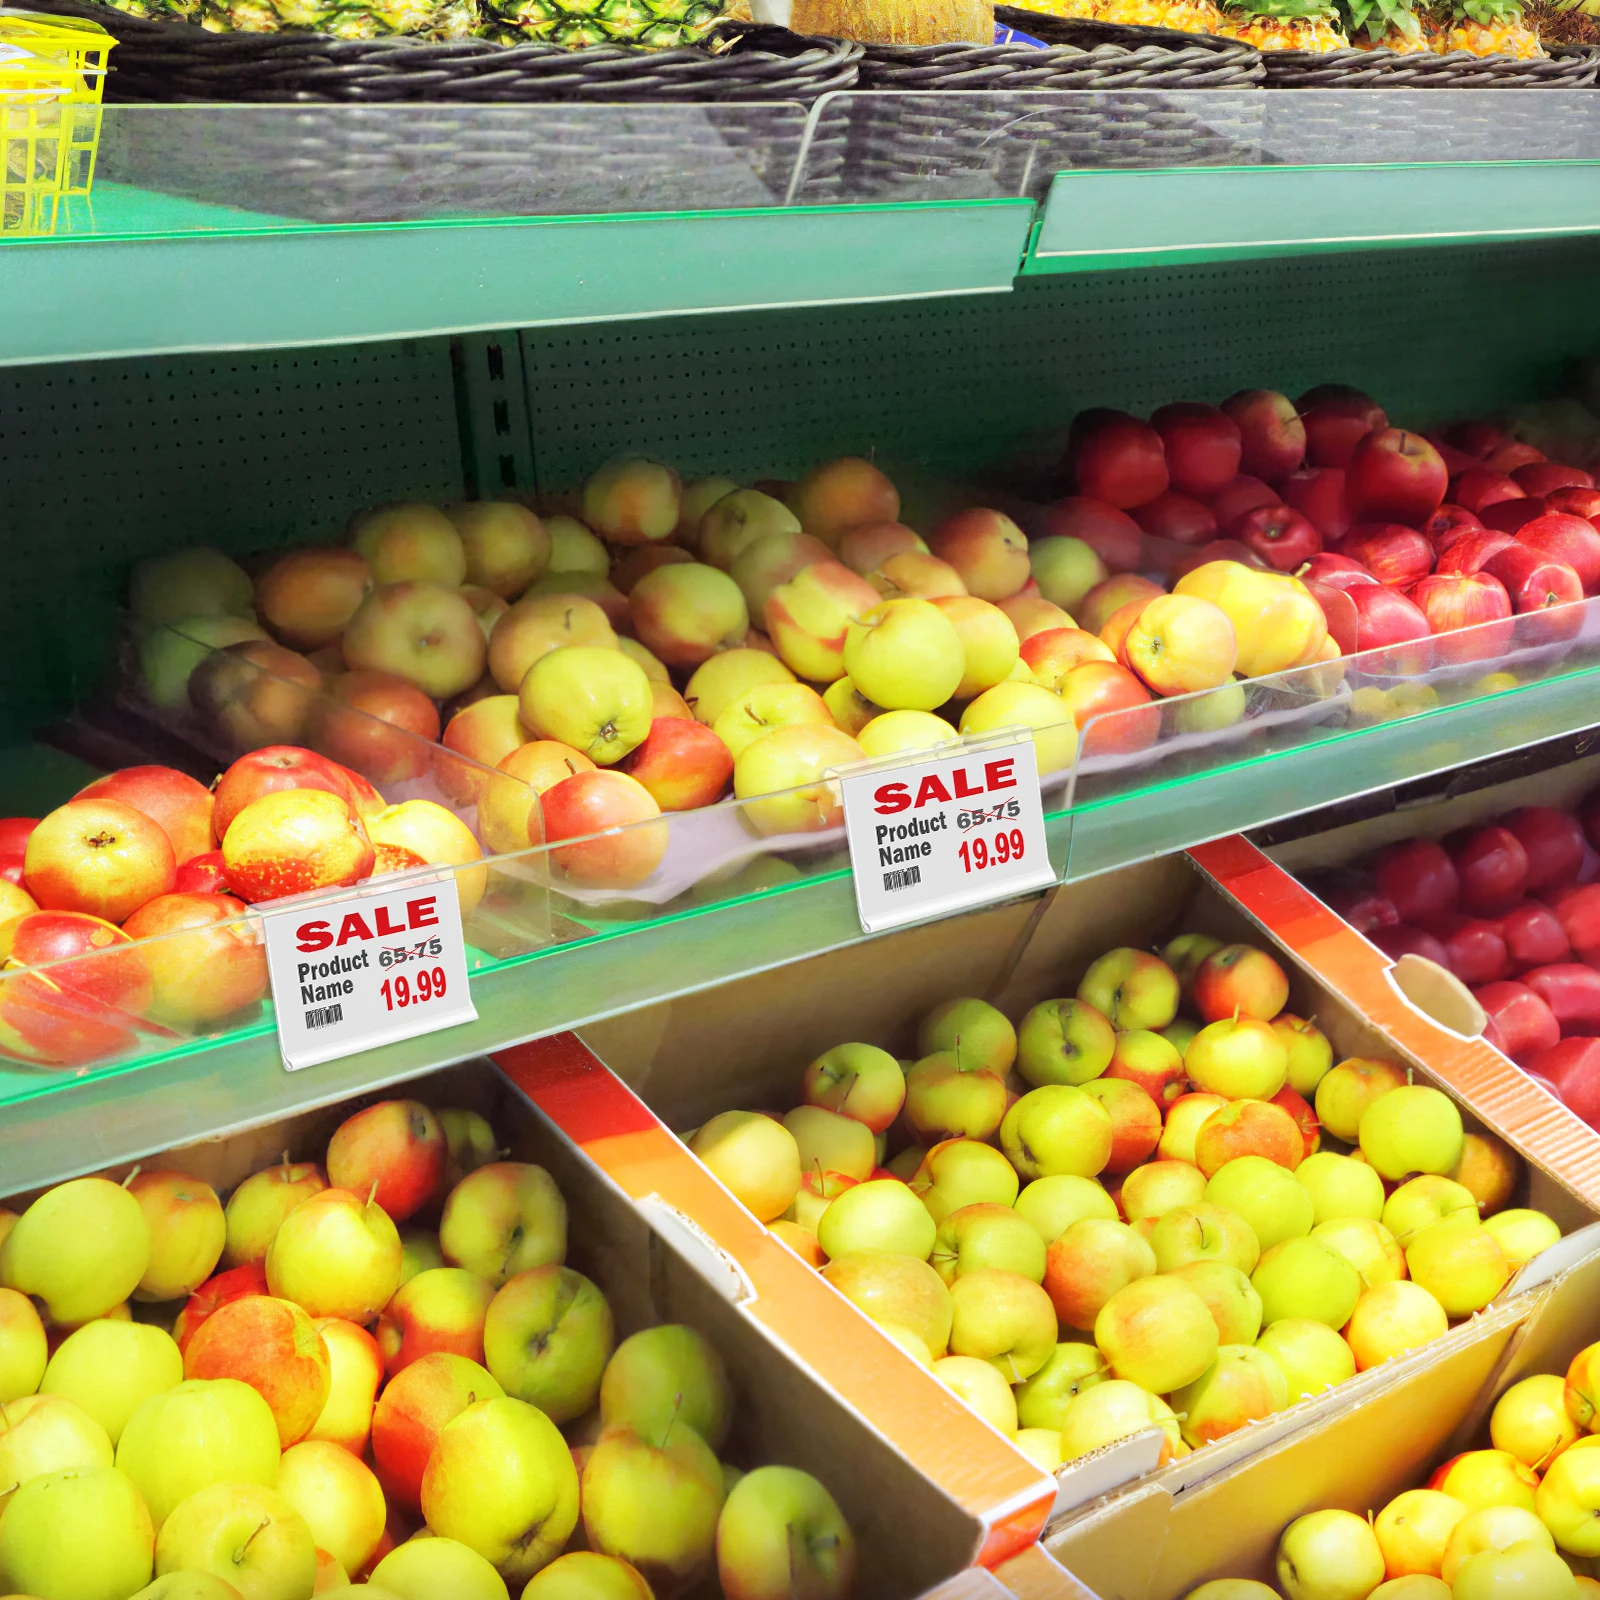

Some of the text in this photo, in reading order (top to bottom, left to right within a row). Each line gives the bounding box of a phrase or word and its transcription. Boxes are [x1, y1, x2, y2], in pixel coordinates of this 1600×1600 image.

[874, 758, 1017, 815] SALE
[876, 811, 947, 845] Product
[957, 800, 1021, 829] 65.75
[878, 841, 931, 867] Name
[958, 829, 1024, 873] 19.99
[296, 896, 439, 953] SALE
[297, 949, 369, 983] Product
[379, 938, 443, 967] 65.75
[300, 979, 354, 1005] Name
[380, 966, 447, 1011] 19.99
